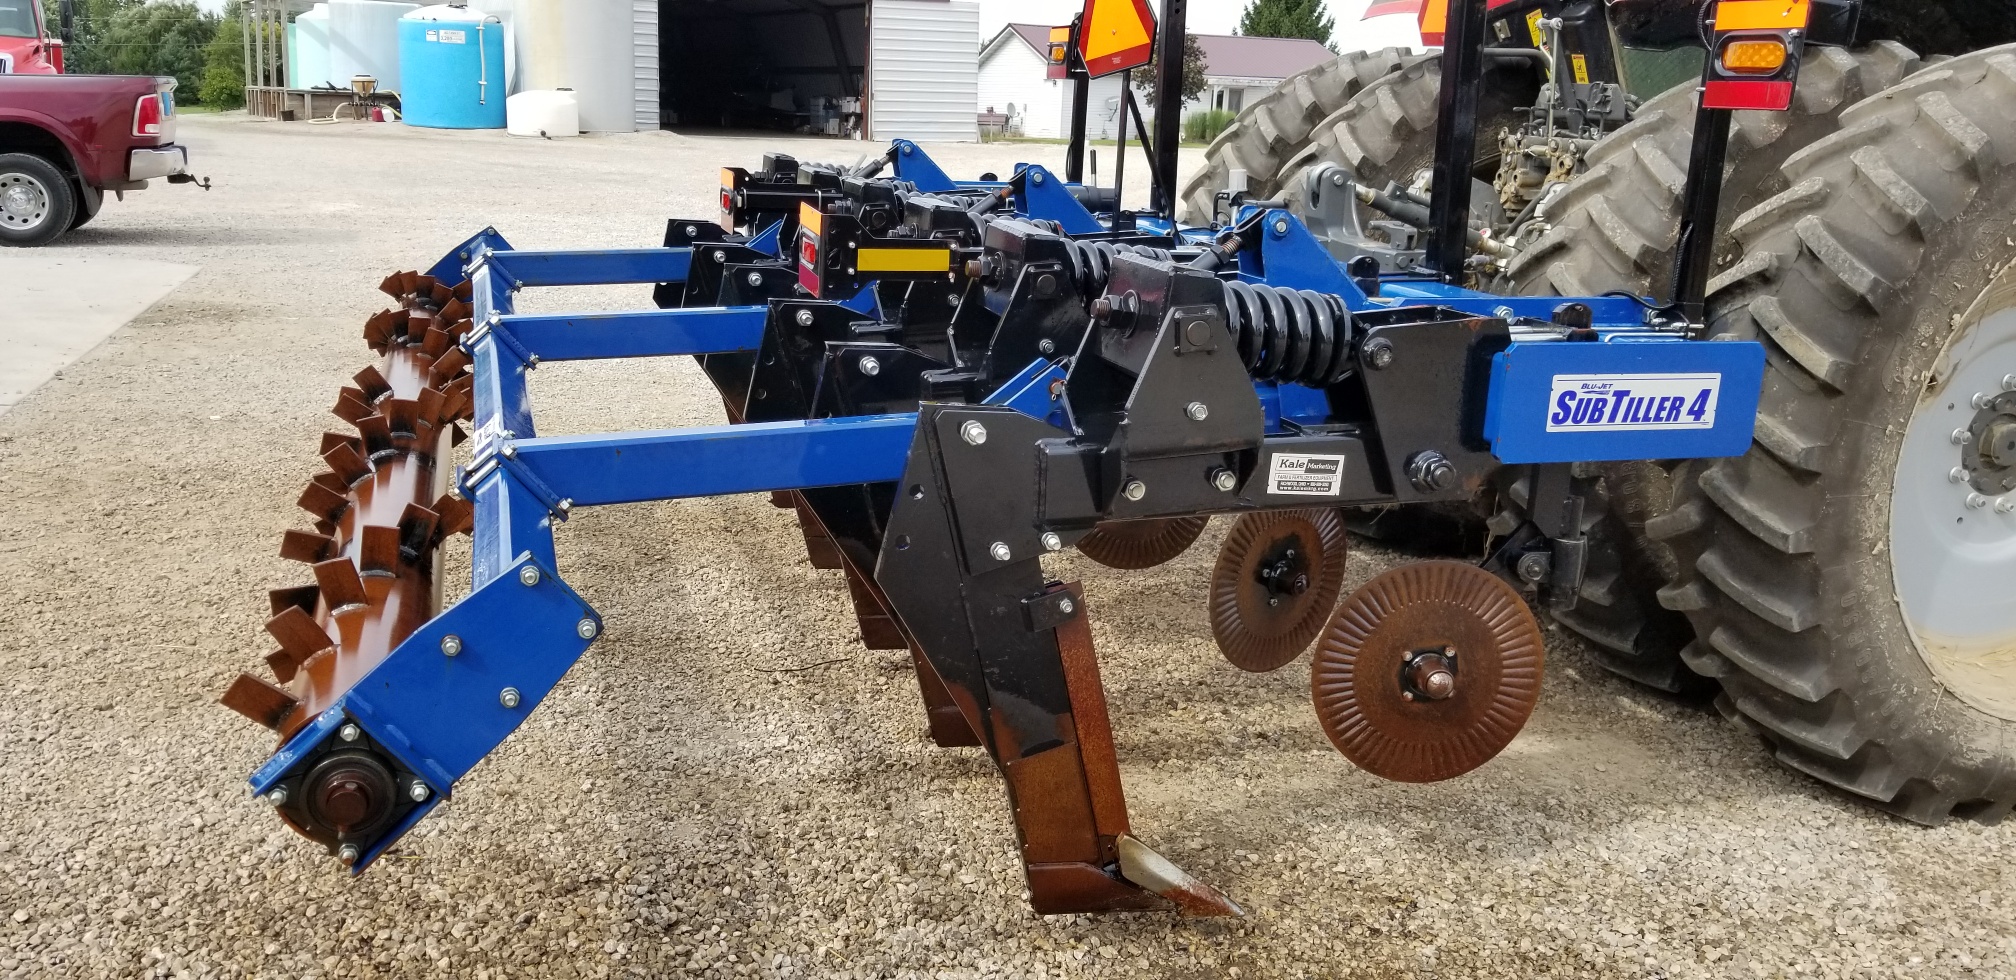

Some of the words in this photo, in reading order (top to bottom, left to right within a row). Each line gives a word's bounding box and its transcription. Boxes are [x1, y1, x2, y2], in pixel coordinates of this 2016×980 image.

[1686, 388, 1713, 422] 4
[1279, 459, 1305, 468] Kale
[1307, 462, 1337, 471] Marketing
